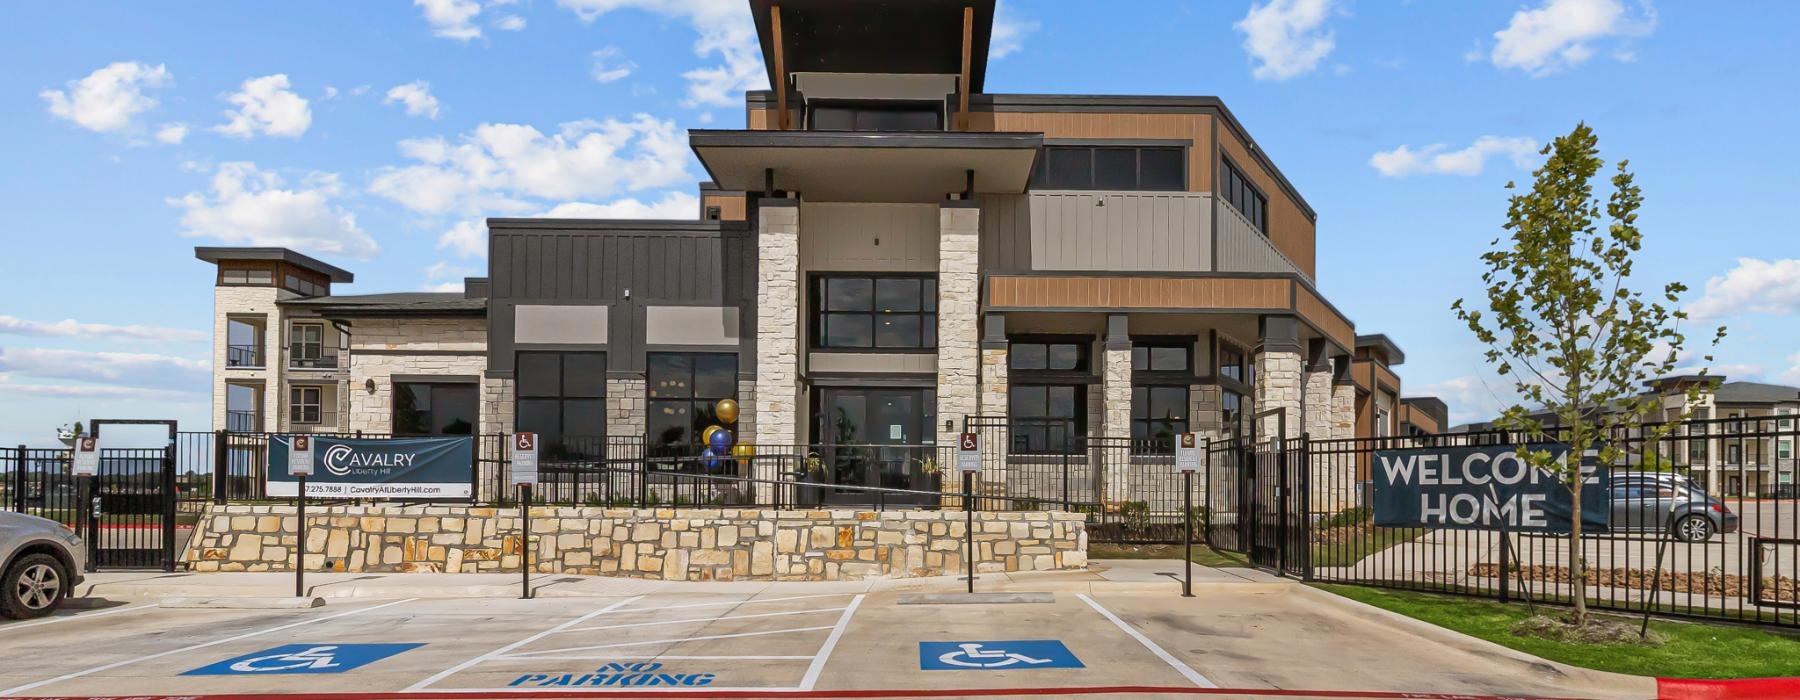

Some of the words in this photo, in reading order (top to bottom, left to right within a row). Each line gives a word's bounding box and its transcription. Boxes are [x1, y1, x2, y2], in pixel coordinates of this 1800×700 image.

[1381, 449, 1600, 485] WELCOME
[305, 485, 342, 493] 7.275.7888
[1420, 493, 1547, 527] HOME
[596, 662, 663, 672] NO
[507, 673, 716, 688] PARKING
